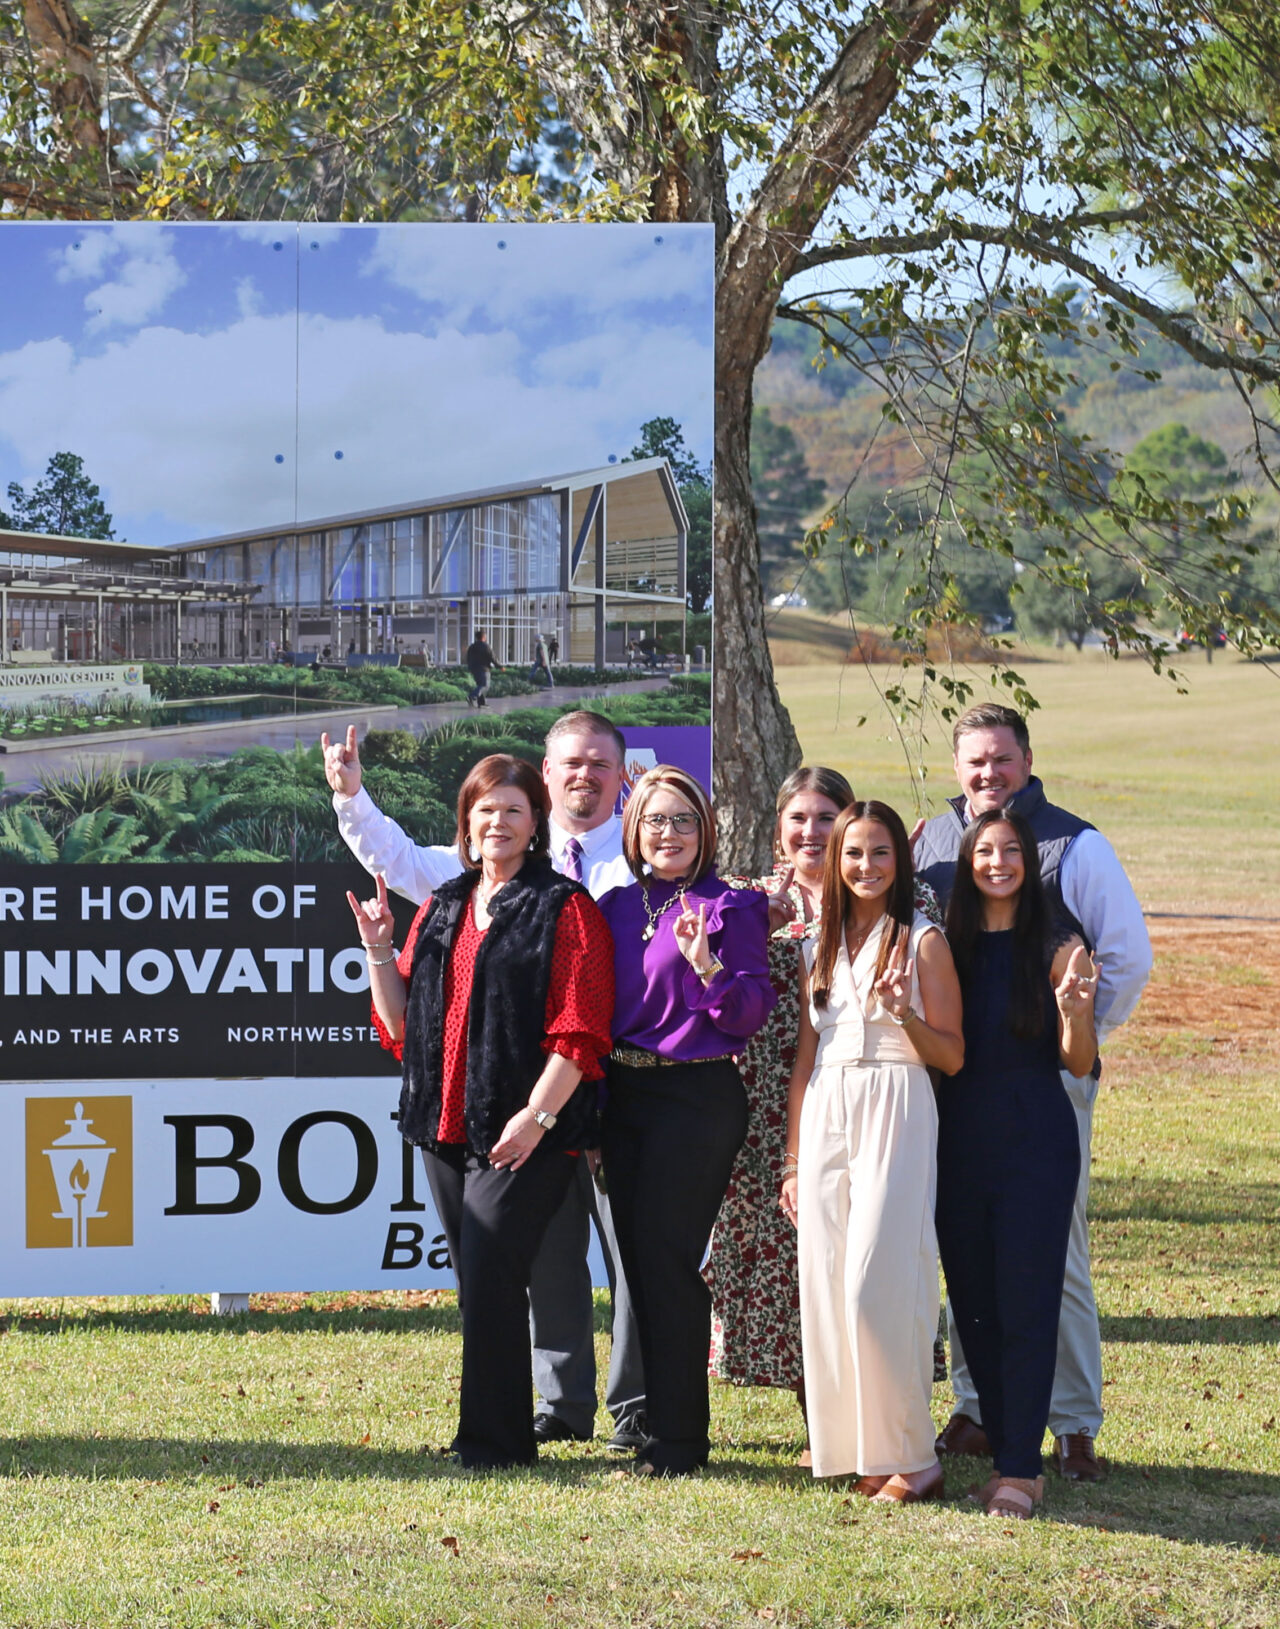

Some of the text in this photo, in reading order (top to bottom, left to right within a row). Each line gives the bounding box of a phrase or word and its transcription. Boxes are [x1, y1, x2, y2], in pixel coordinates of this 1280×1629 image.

[70, 671, 116, 684] CENTER
[81, 885, 229, 921] HOME
[251, 884, 317, 920] OF
[3, 946, 402, 996] INNOVATIO
[12, 1029, 61, 1045] AND
[69, 1028, 113, 1044] THE
[122, 1027, 180, 1044] ARTS
[227, 1026, 381, 1042] NORTHWESTE
[381, 1222, 453, 1270] Ba
